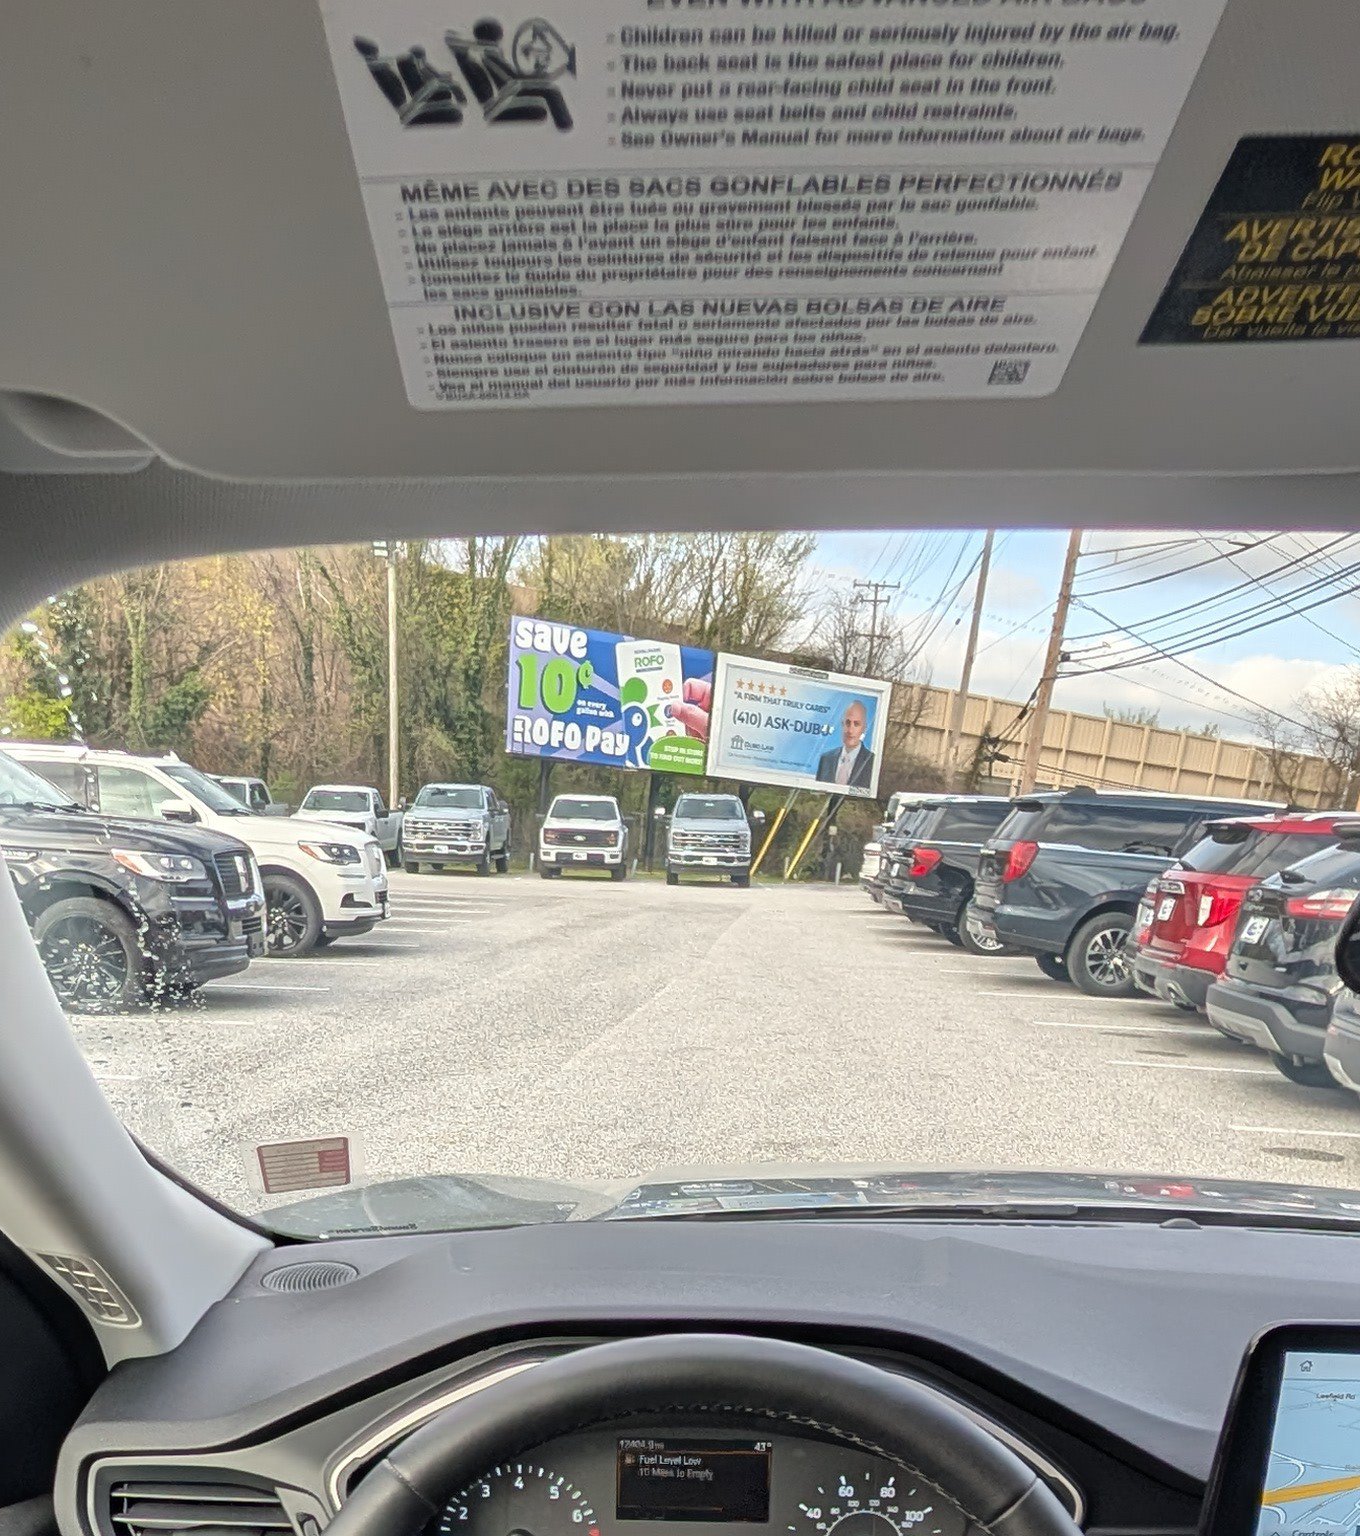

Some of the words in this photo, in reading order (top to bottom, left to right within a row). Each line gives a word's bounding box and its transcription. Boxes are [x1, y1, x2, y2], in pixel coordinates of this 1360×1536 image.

[401, 179, 478, 202] MÊME
[489, 179, 557, 200] AVEC
[567, 178, 620, 199] DES
[629, 176, 701, 198] SACS
[710, 174, 890, 196] GONFLABLES
[899, 168, 1123, 192] PERFECTIONNÉS
[1237, 240, 1287, 263] DE
[454, 302, 581, 321] INCLUSIVE
[588, 301, 640, 318] CON
[648, 300, 694, 317] LAS
[702, 299, 798, 316] NUEVAS
[806, 298, 903, 315] BOLSAS
[910, 298, 942, 314] DE
[948, 296, 1008, 313] AIRE
[1192, 303, 1295, 326] SOBRE
[634, 655, 664, 668] ROFO
[744, 692, 762, 705] FIRM
[762, 695, 781, 707] THAT
[782, 699, 804, 710] TRULY
[733, 708, 762, 728] (410)
[513, 715, 581, 750] ROFO
[639, 1454, 657, 1464] Fuel
[659, 1454, 681, 1465] Level
[683, 1455, 701, 1465] Low
[515, 1477, 524, 1489] 4
[482, 1484, 490, 1498] 3
[549, 1486, 559, 1500] 5
[838, 1486, 854, 1498] 60
[880, 1486, 896, 1498] 80
[459, 1507, 468, 1520] 2
[572, 1510, 582, 1523] 6
[806, 1508, 822, 1519] 40
[905, 1510, 924, 1522] 100
